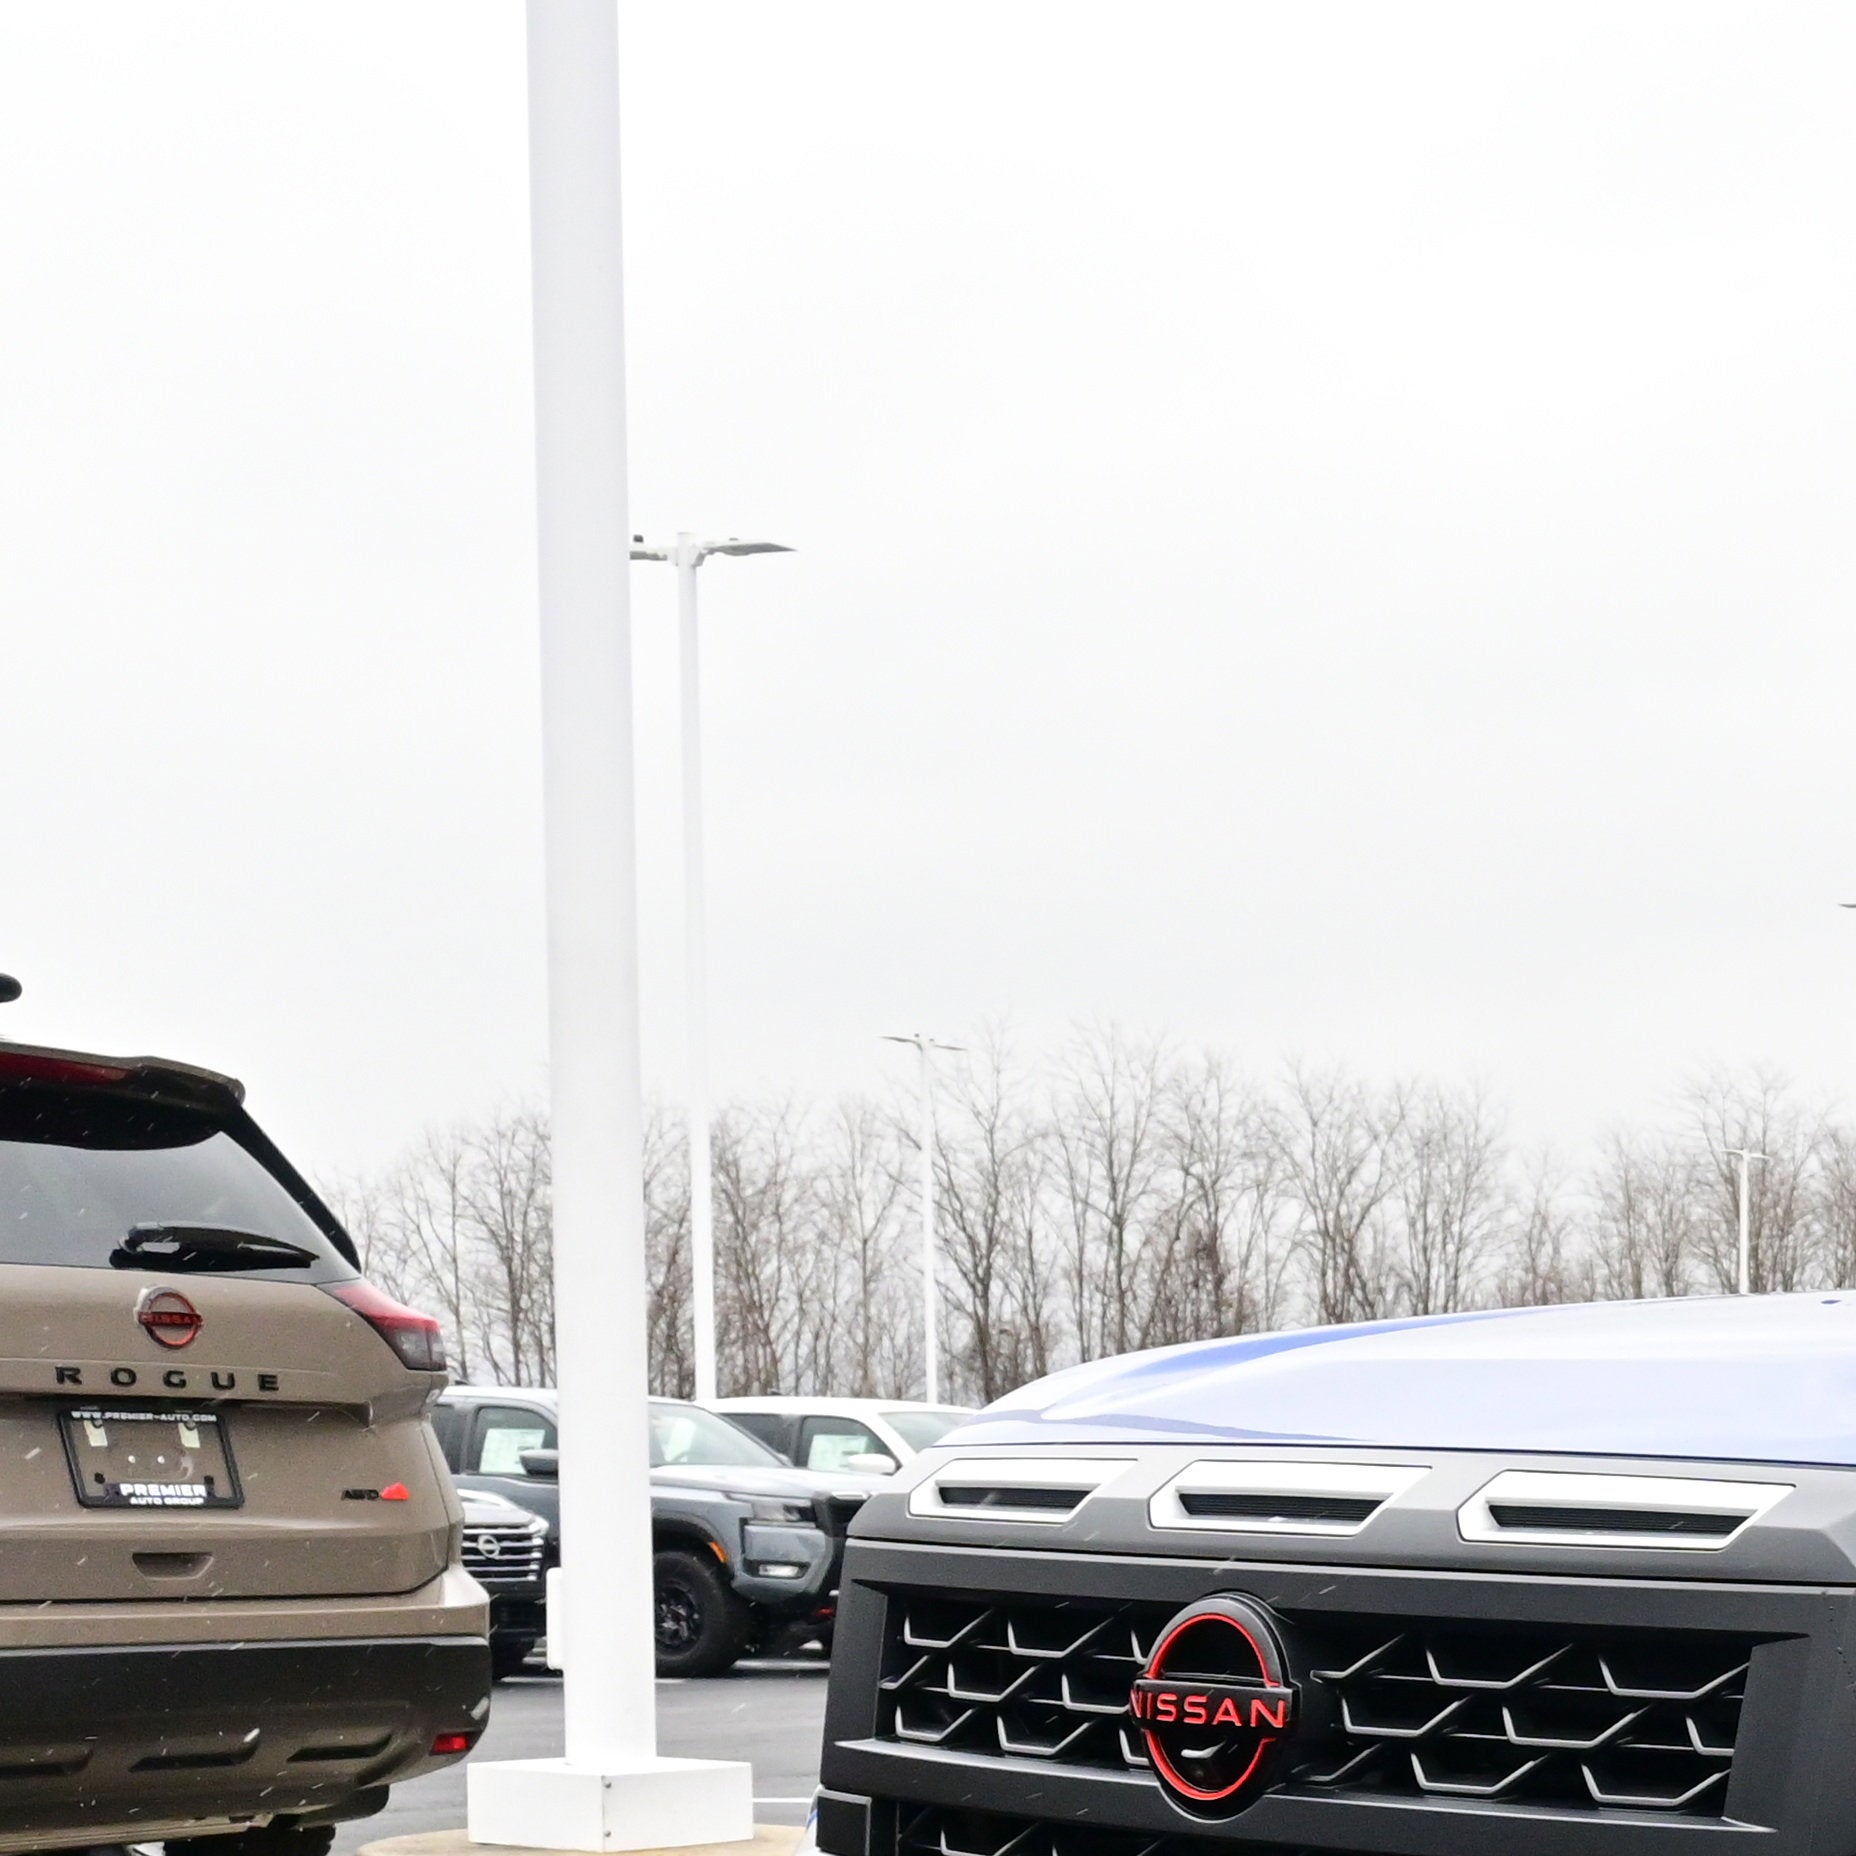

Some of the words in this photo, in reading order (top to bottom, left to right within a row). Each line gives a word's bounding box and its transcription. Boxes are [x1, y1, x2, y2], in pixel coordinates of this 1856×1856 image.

[55, 1366, 280, 1392] ROGUE
[71, 1411, 217, 1422] WWW.PREMIER-AUTO.COM
[119, 1483, 207, 1496] PREMIER
[130, 1497, 163, 1505] AUTO
[165, 1497, 204, 1505] GROUP
[1130, 1689, 1285, 1728] NISSAN
